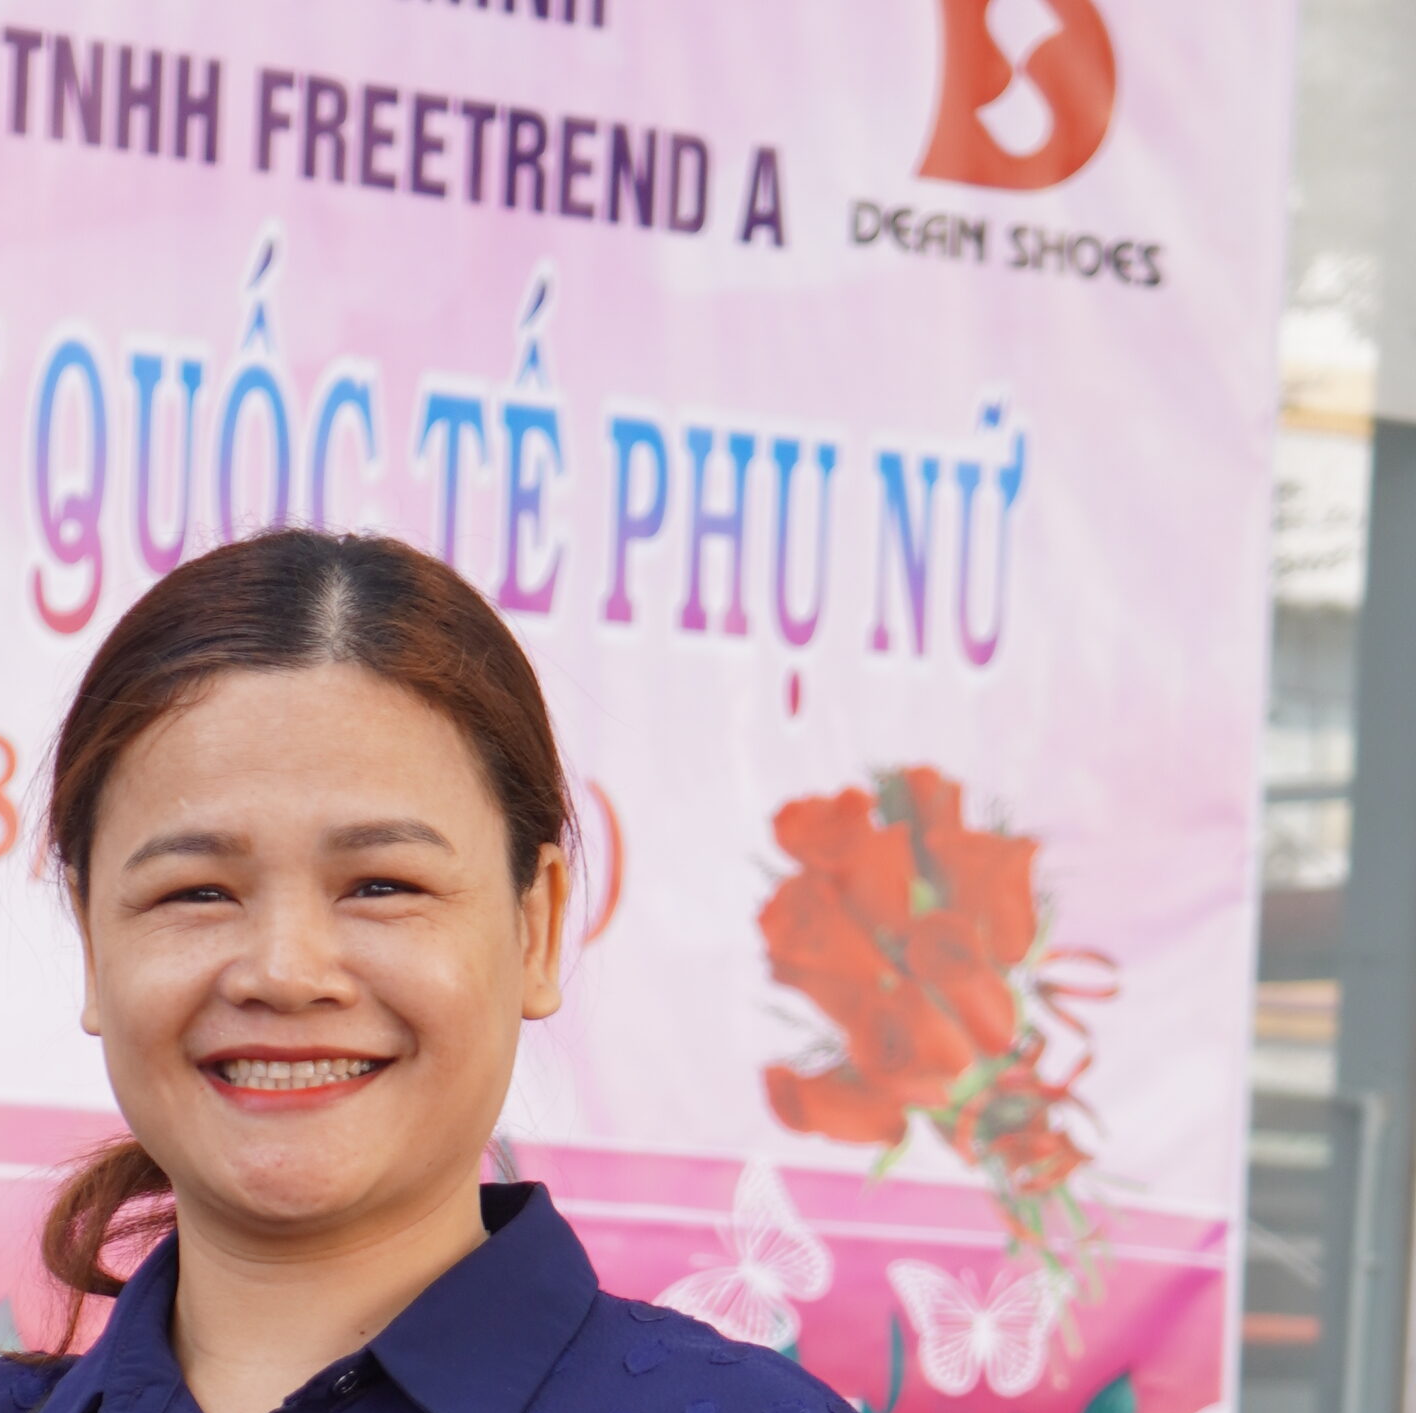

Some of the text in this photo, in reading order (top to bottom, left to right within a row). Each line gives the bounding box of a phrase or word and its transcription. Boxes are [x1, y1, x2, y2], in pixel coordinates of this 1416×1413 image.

[4, 25, 221, 165] TNHH
[257, 66, 708, 233] FREETREND
[741, 146, 786, 247] A
[1009, 224, 1163, 288] SHOES
[34, 240, 376, 635] QUỐC
[417, 277, 563, 612] TẾ
[605, 415, 836, 718] PHỤ
